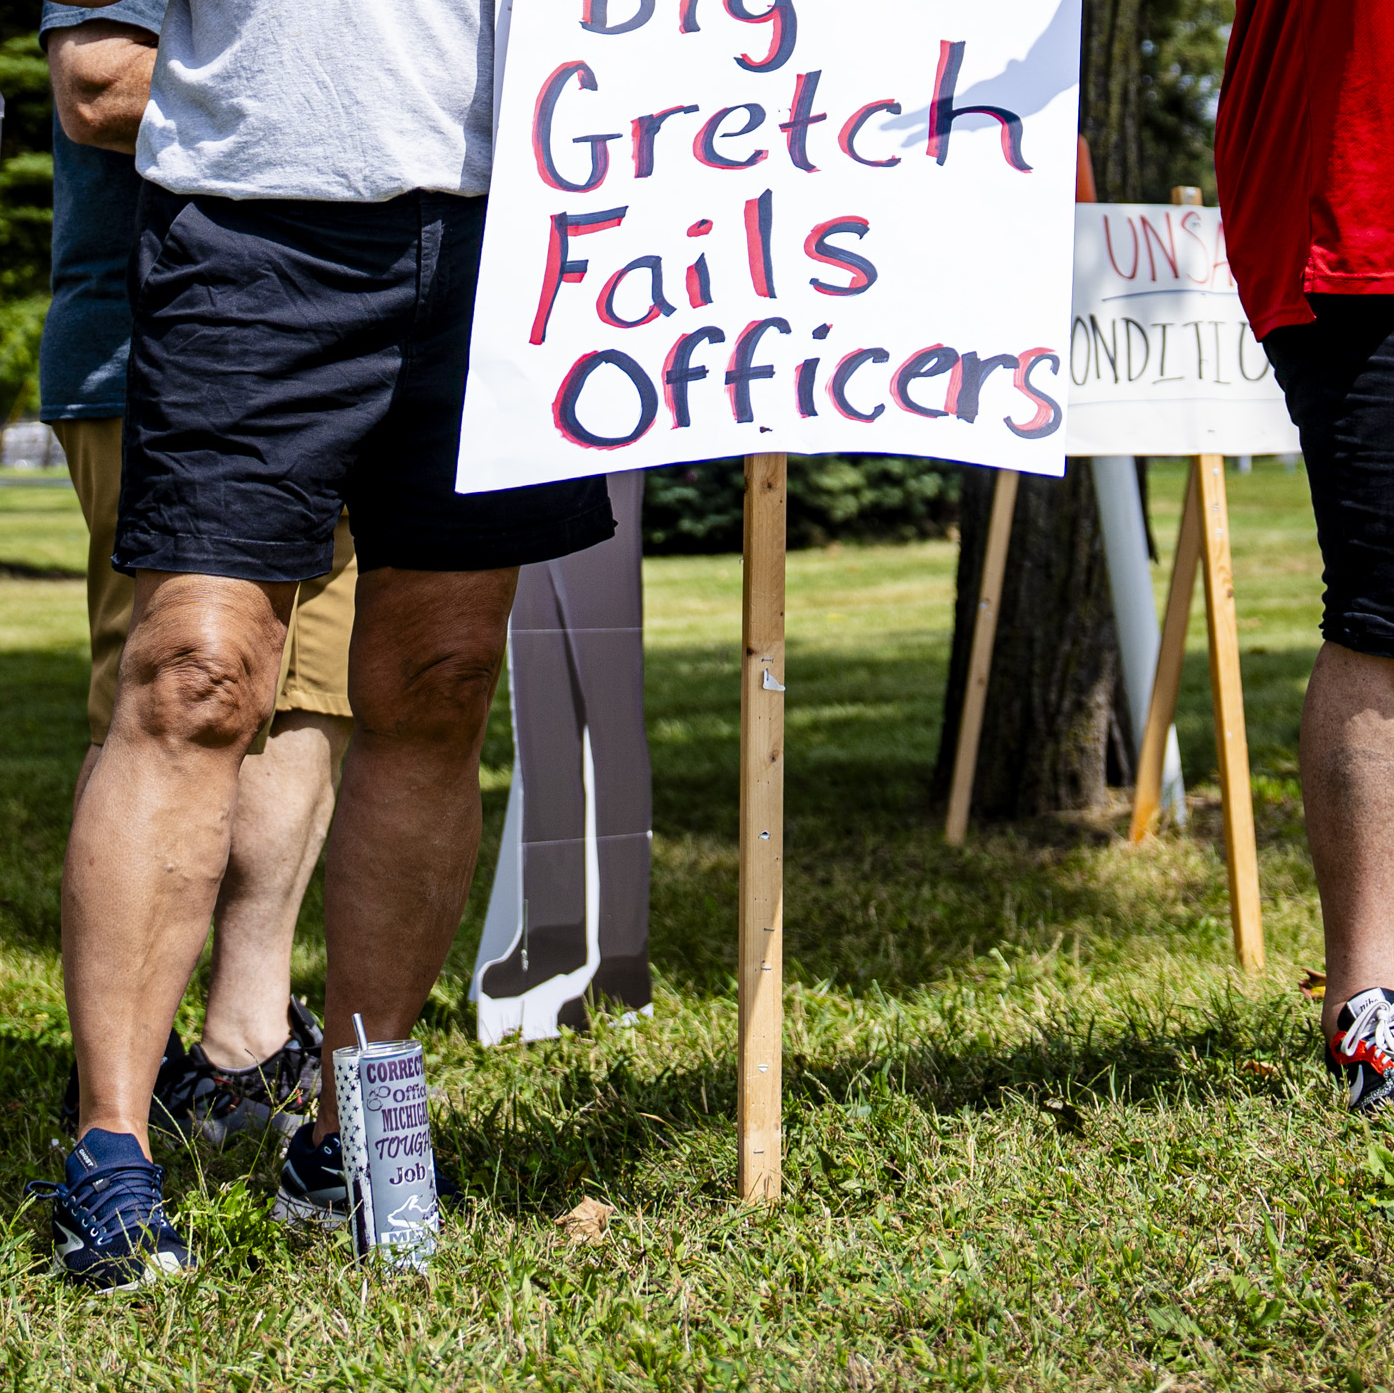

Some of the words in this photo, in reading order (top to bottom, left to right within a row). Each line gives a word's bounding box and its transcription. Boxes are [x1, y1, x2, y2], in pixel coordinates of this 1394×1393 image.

[532, 39, 1033, 193] Gretch
[528, 188, 878, 344] Fails
[552, 317, 1062, 451] Officers
[389, 1162, 426, 1185] Job
